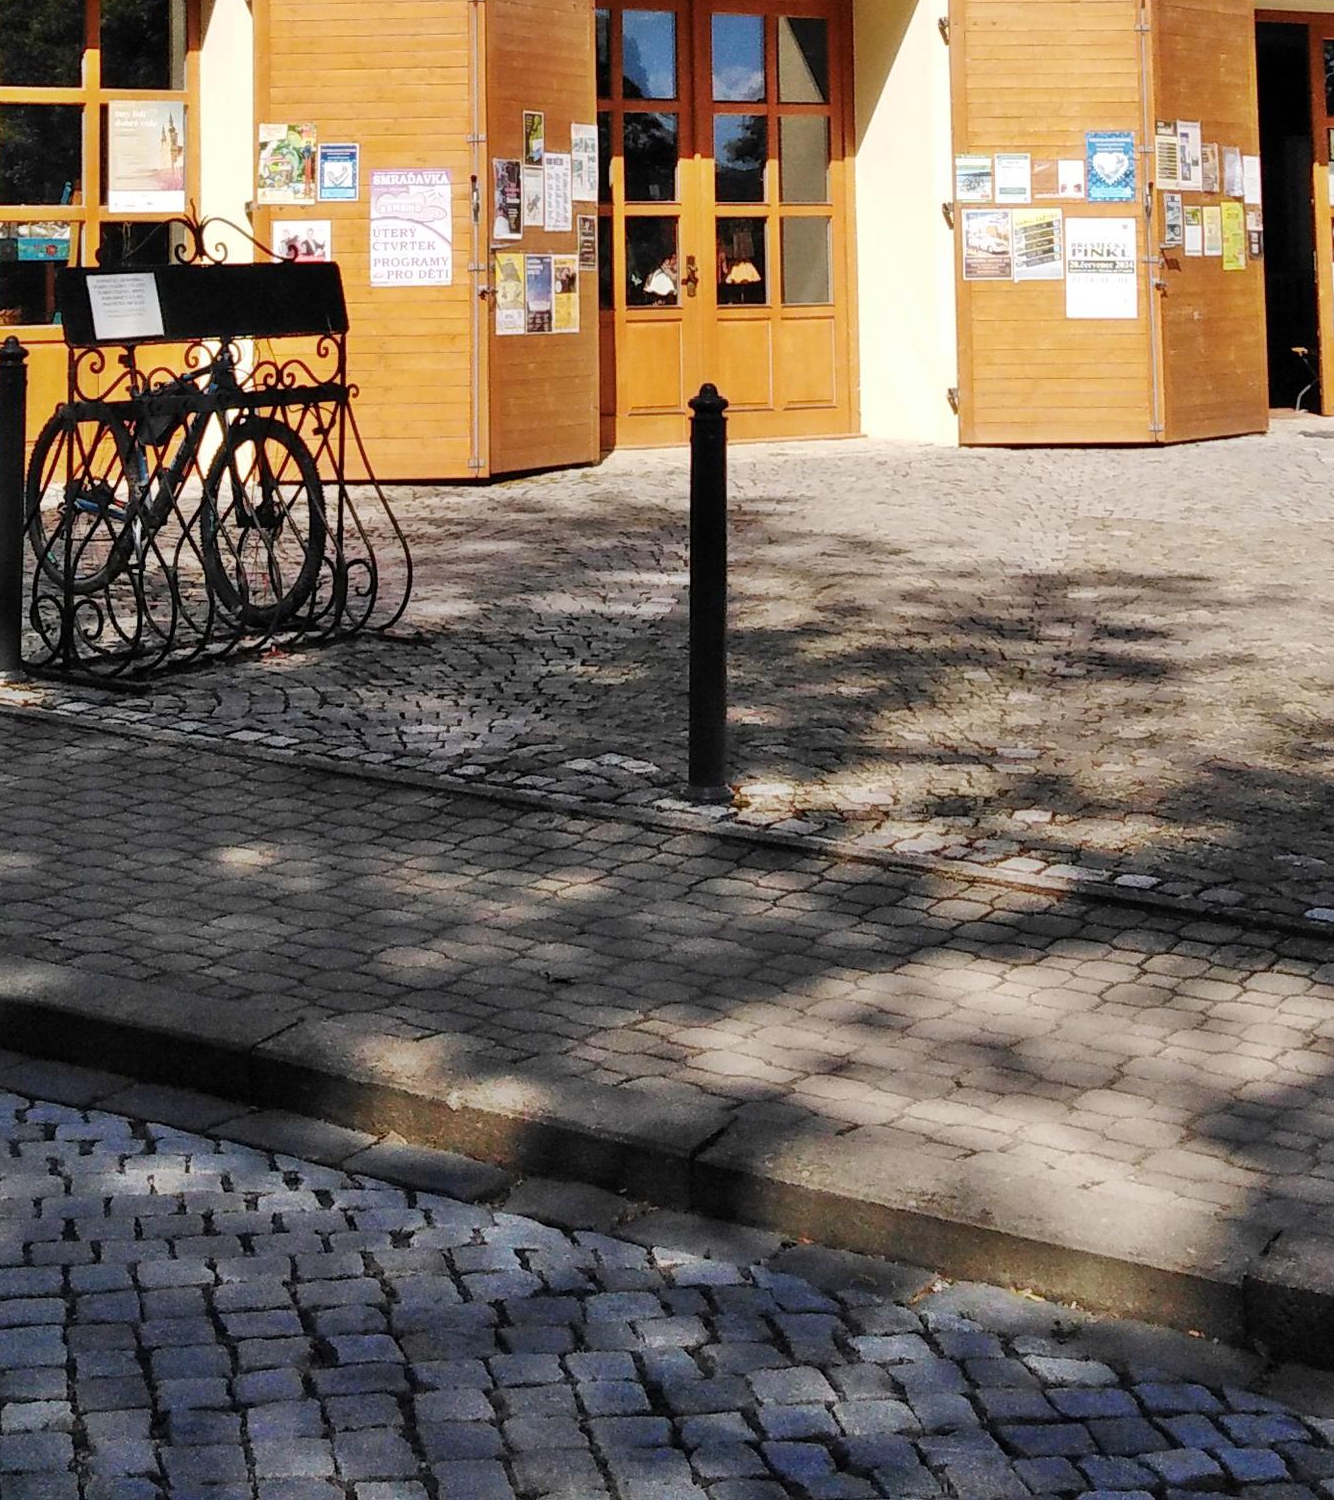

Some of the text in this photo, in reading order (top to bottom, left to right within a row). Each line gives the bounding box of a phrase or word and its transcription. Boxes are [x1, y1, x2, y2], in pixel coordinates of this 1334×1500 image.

[373, 257, 450, 268] PROGRAMY
[387, 267, 450, 280] PRO DĚTI
